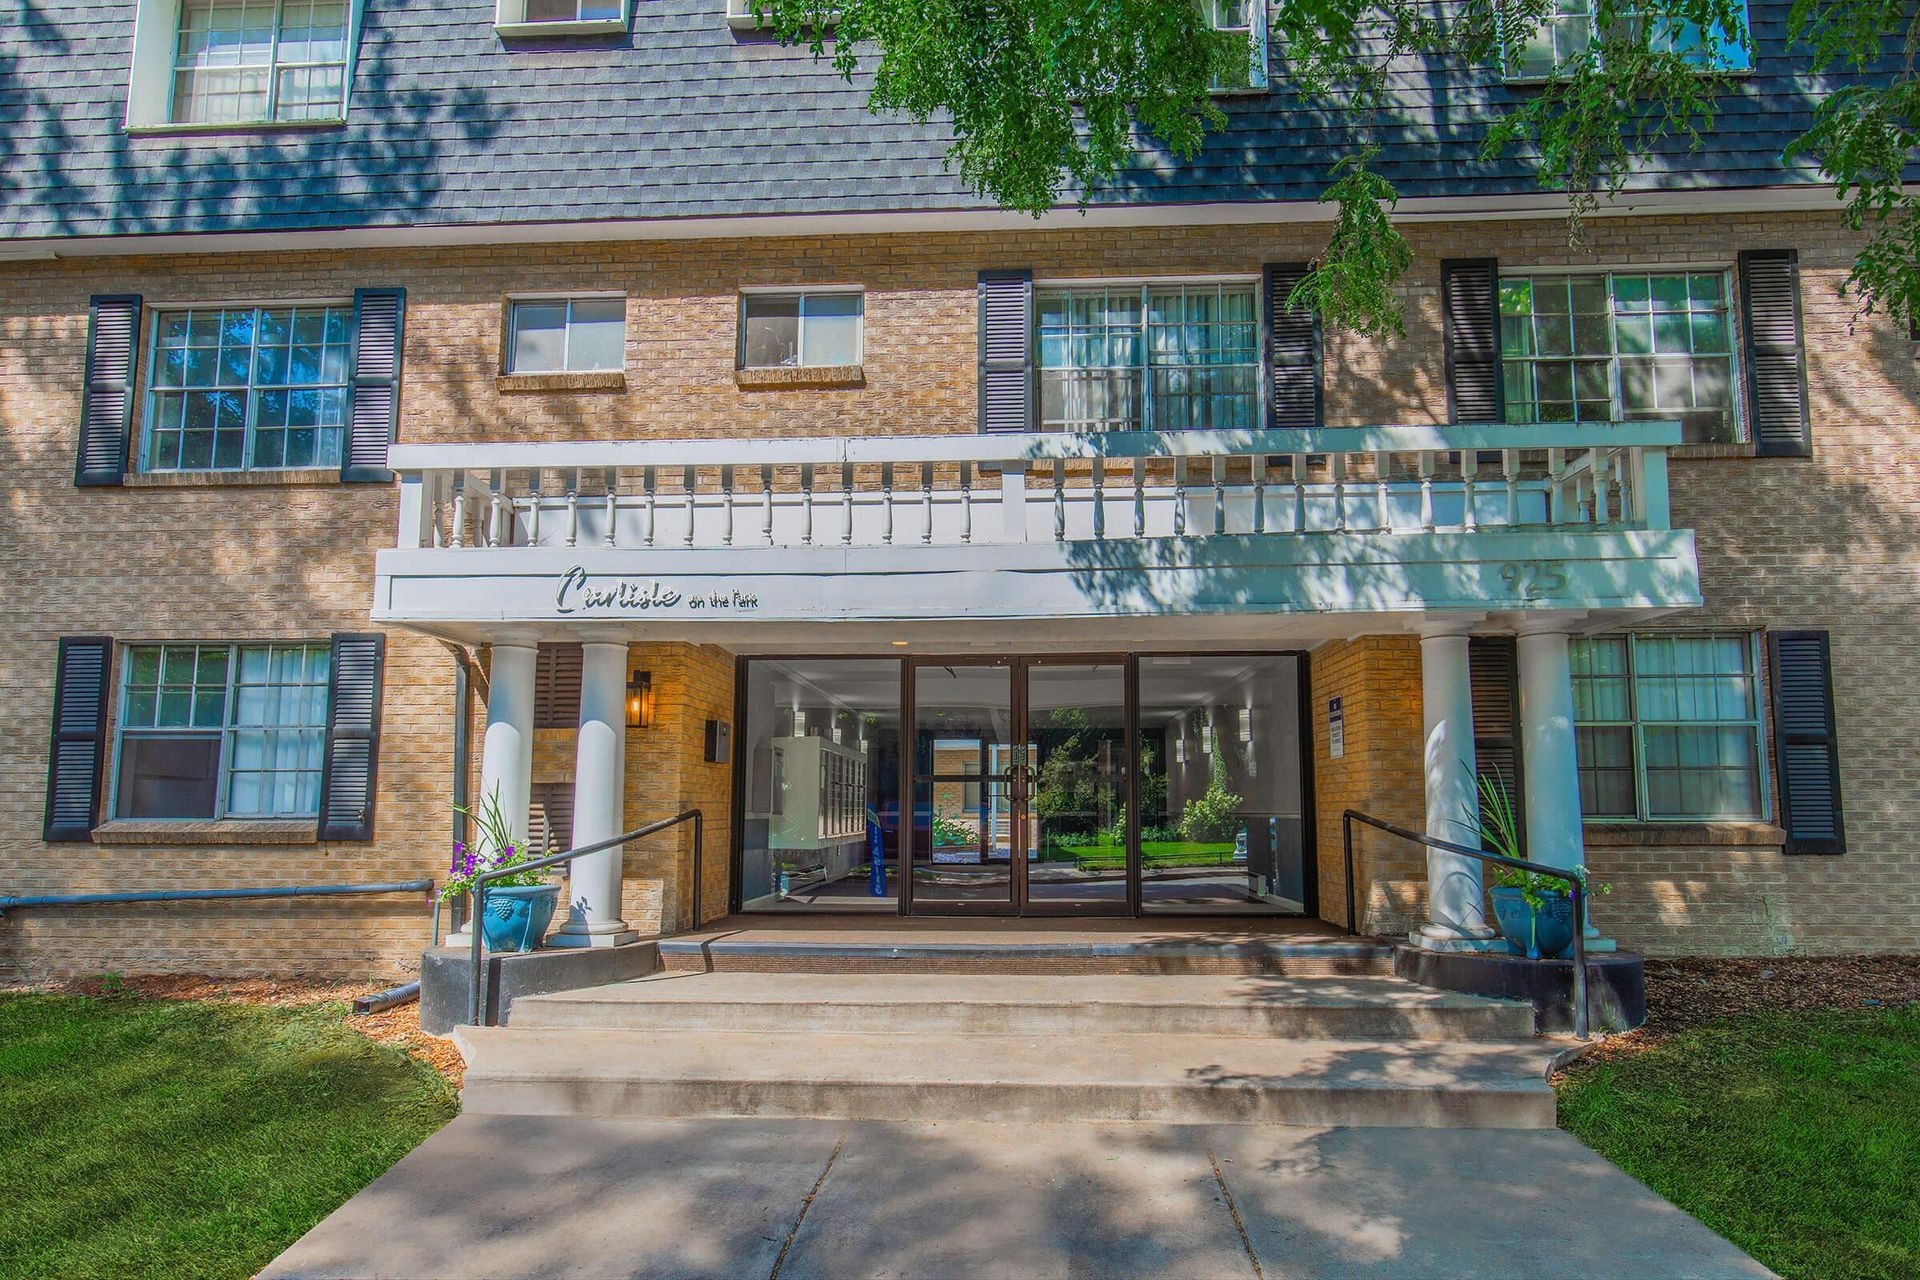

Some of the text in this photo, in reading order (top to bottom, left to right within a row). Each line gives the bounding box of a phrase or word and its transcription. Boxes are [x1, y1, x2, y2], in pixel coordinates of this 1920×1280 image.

[556, 565, 759, 614] Carlisle on the Park
[1501, 560, 1567, 597] 925
